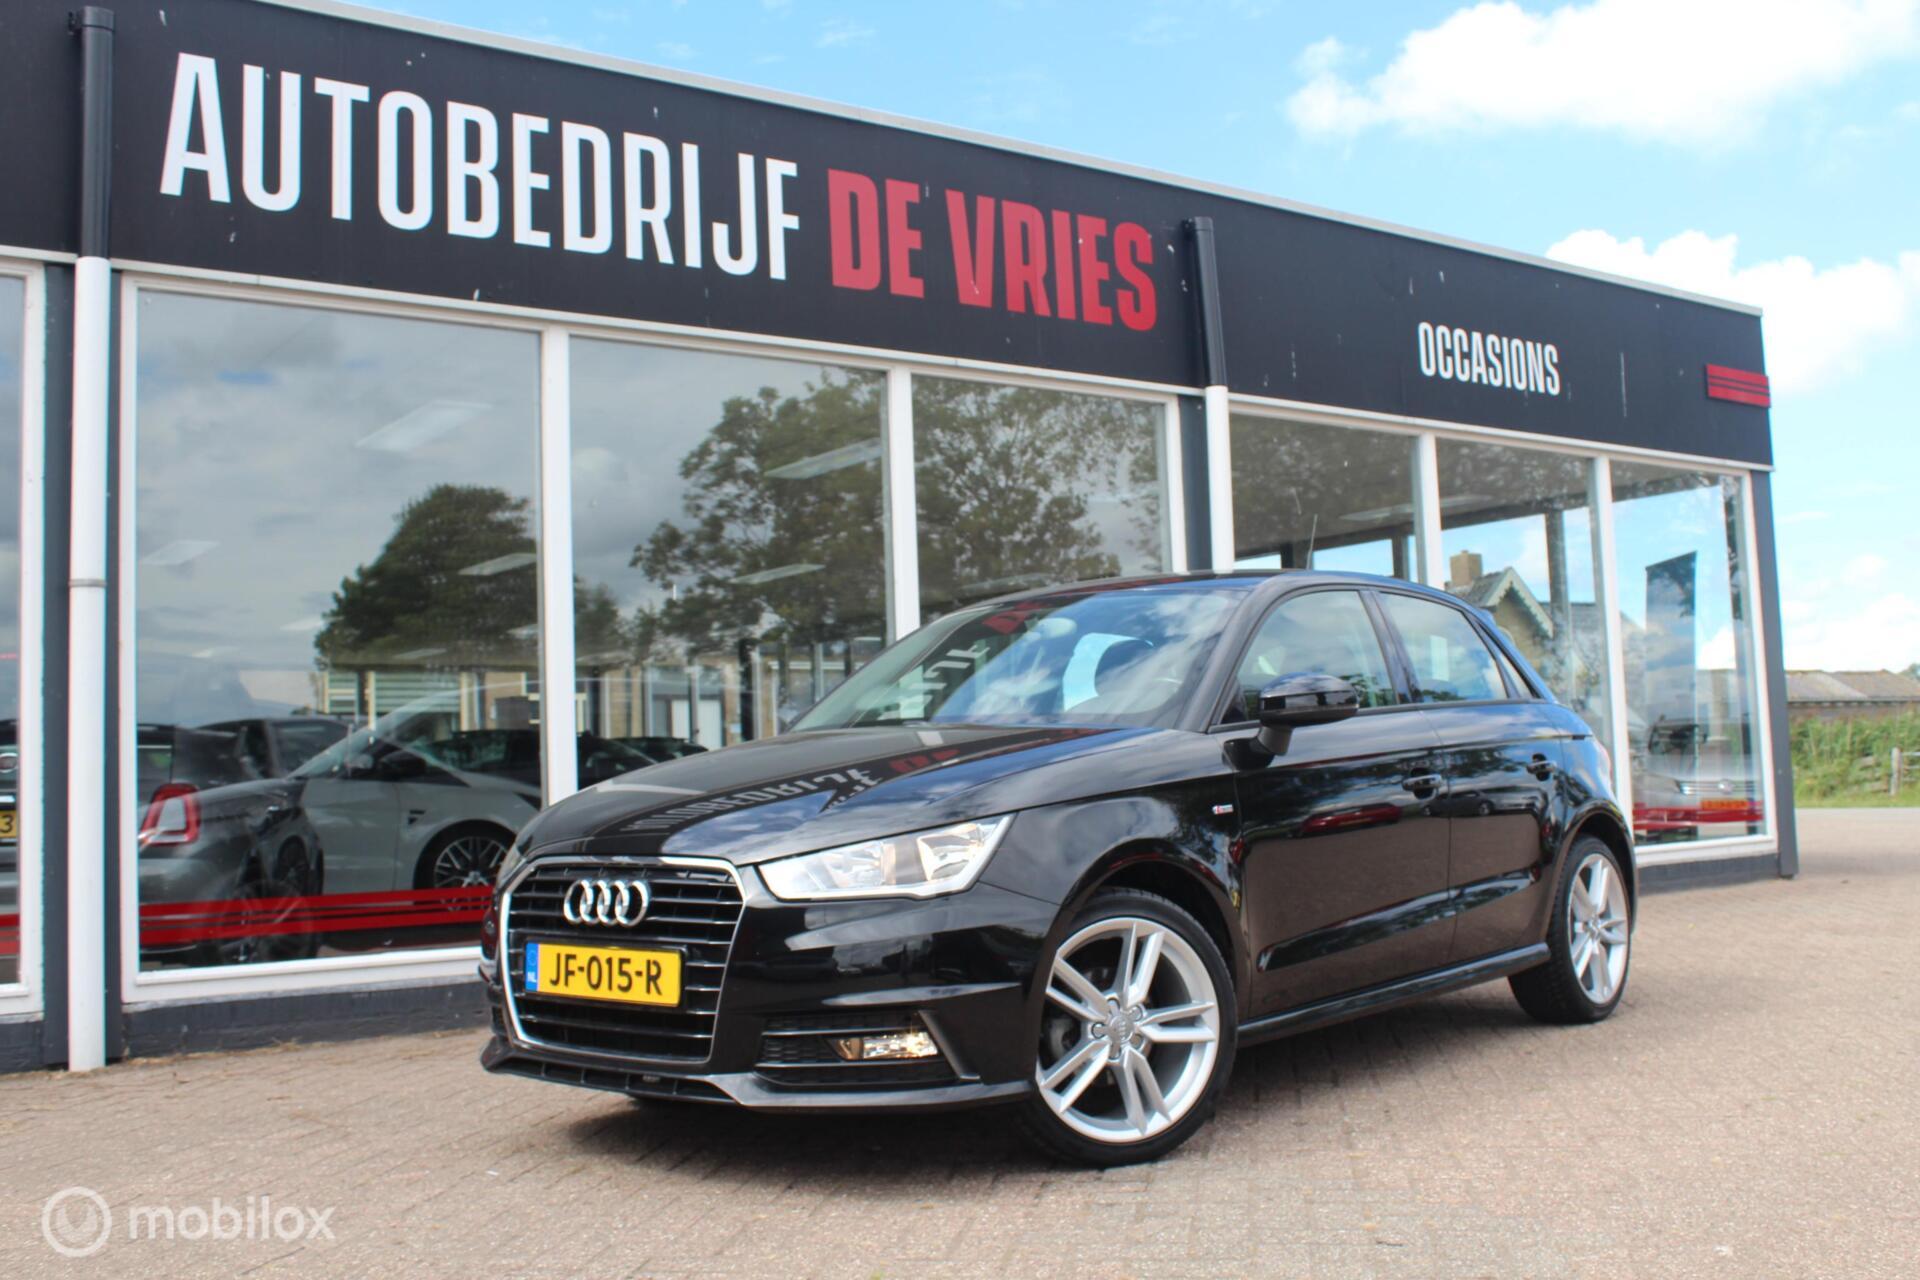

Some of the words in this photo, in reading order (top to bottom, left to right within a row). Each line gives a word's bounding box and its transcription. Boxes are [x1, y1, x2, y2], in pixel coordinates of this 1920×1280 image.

[160, 52, 801, 281] AUTOBEDRIJF
[827, 168, 925, 299] DE
[945, 188, 1158, 332] VRIES
[1417, 321, 1561, 396] OCCASIONS
[549, 952, 663, 996] JF-015-R
